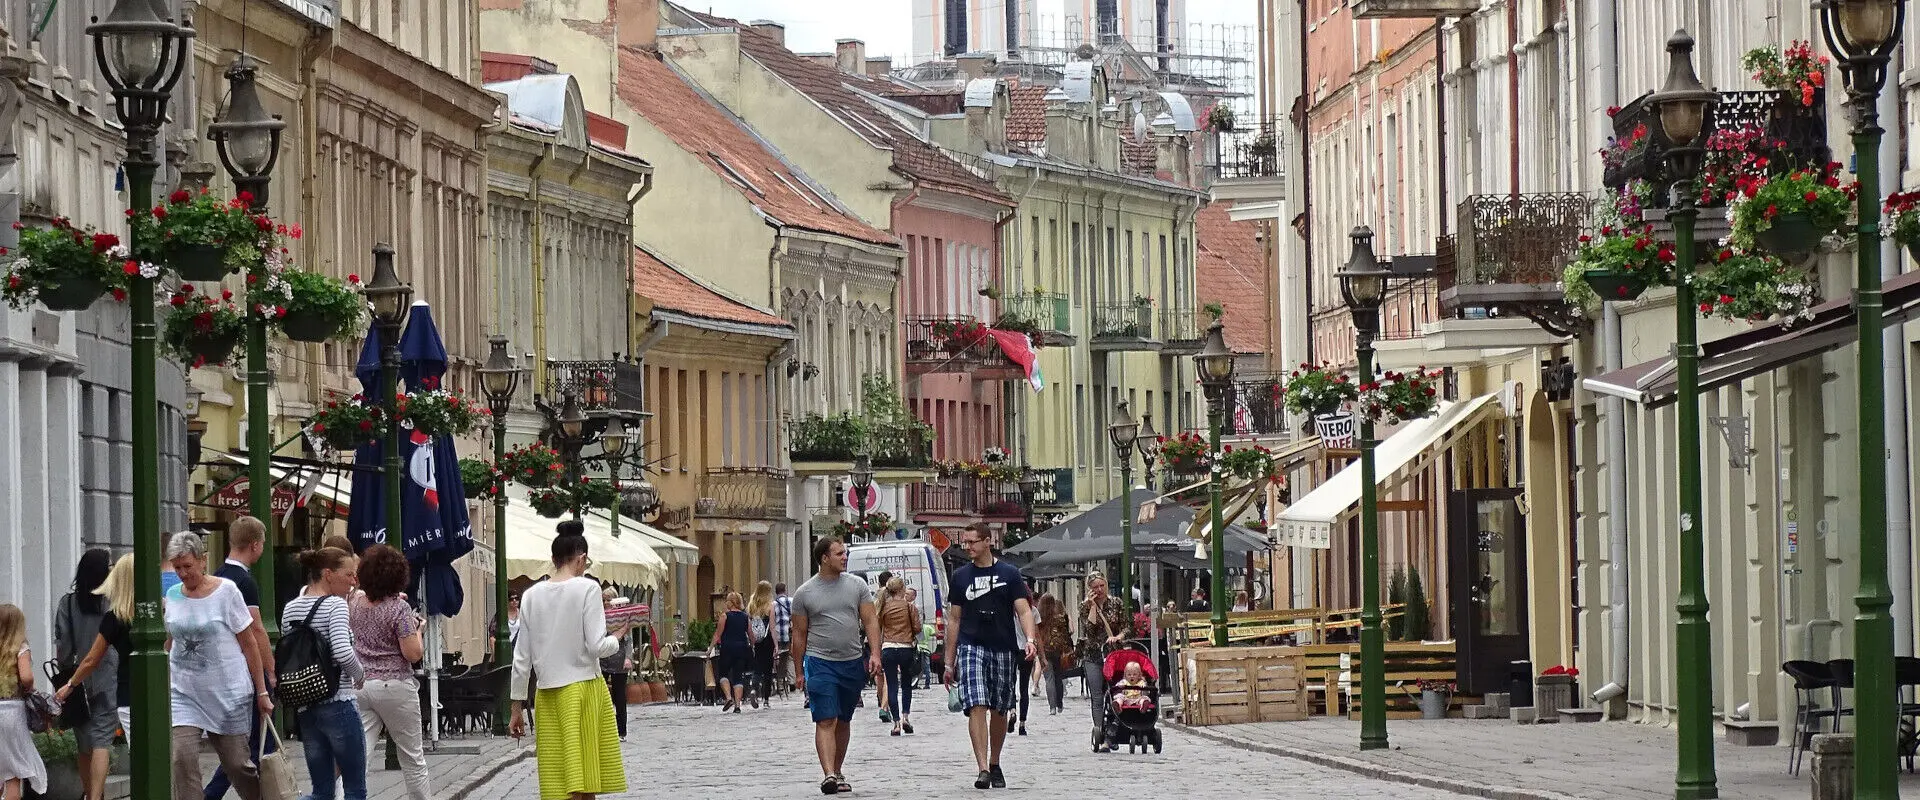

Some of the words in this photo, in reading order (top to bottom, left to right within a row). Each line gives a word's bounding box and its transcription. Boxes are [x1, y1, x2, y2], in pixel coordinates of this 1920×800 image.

[1319, 420, 1352, 437] VERO
[1325, 436, 1352, 449] CAFE
[975, 575, 999, 589] NIKE
